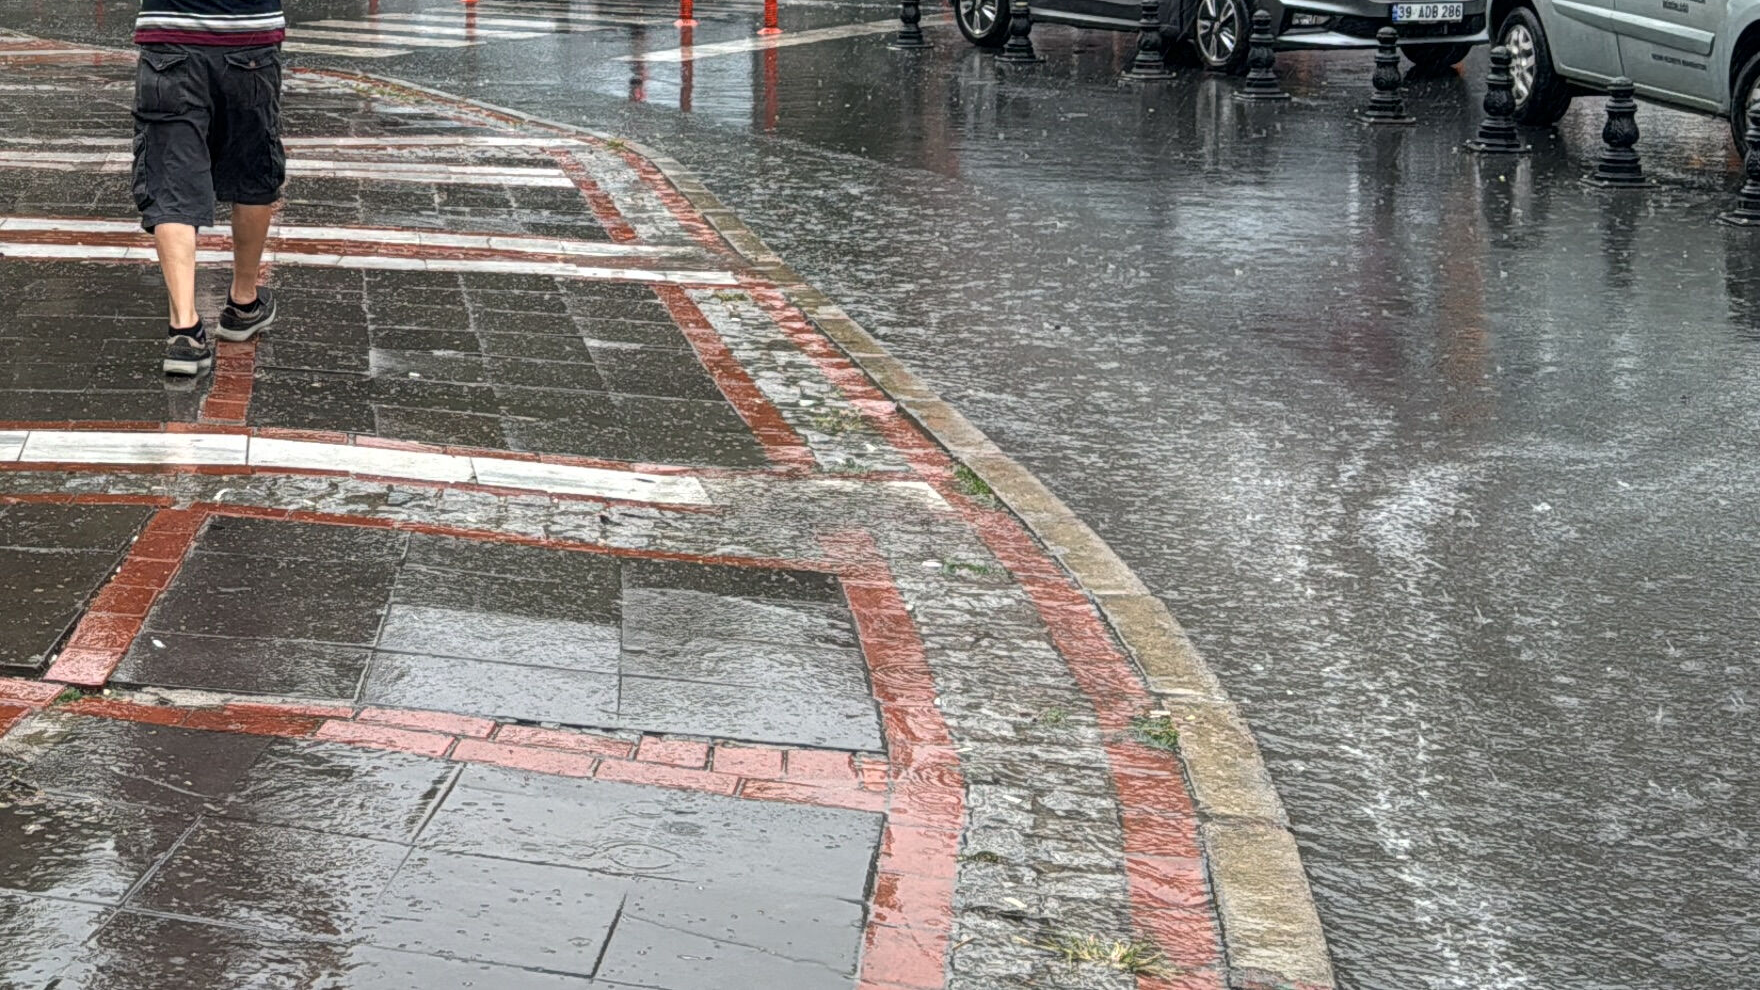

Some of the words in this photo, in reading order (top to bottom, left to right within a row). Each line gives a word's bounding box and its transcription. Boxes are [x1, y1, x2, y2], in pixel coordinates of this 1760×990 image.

[1398, 5, 1412, 19] 39
[1418, 5, 1439, 19] ADB
[1441, 4, 1461, 18] 286
